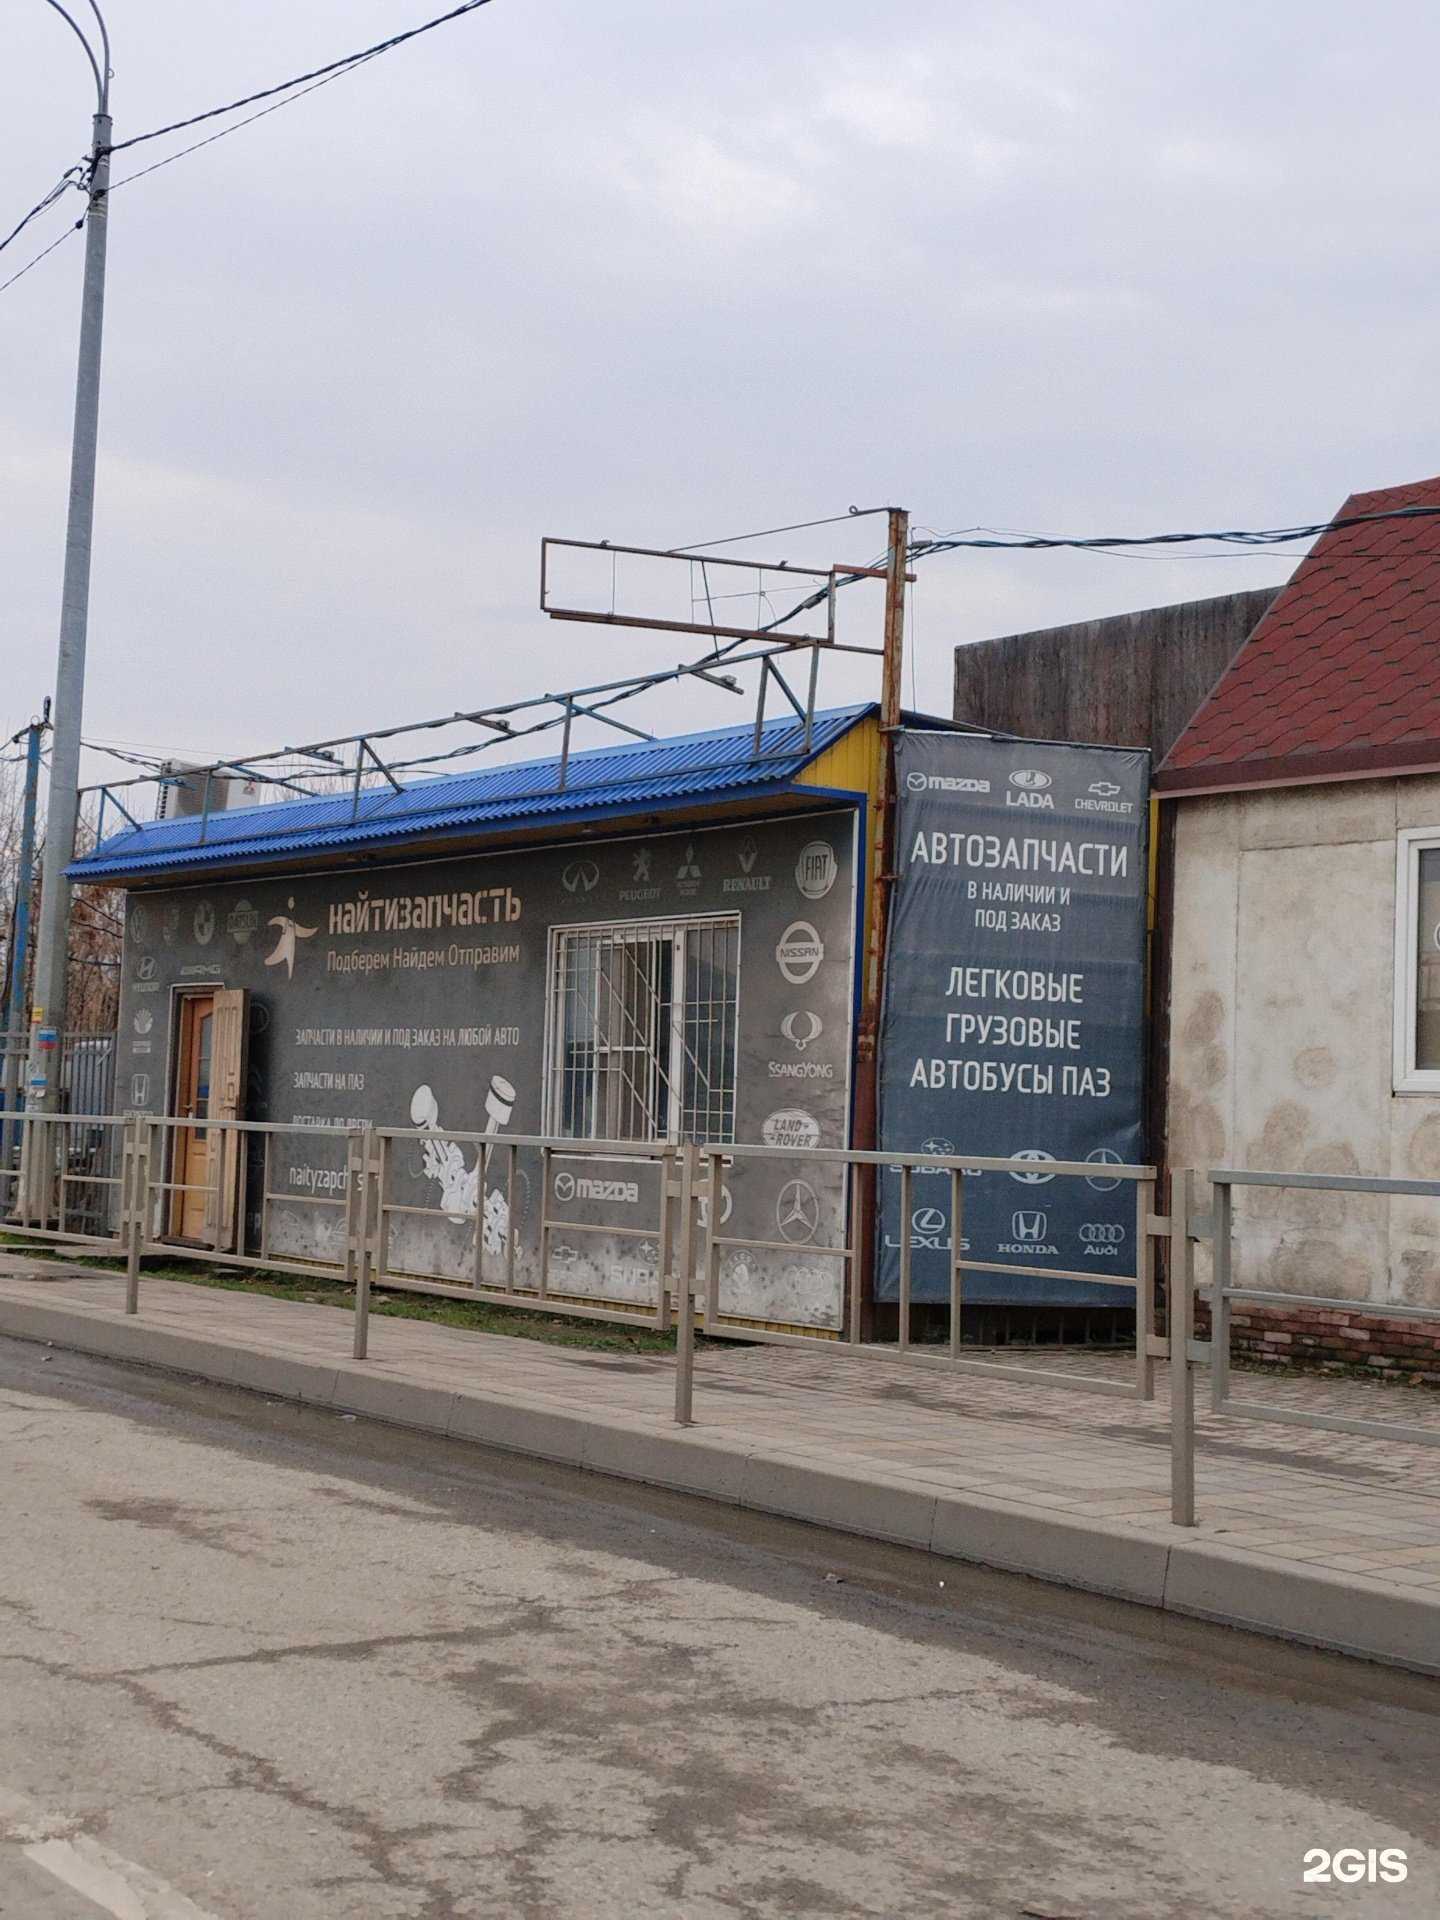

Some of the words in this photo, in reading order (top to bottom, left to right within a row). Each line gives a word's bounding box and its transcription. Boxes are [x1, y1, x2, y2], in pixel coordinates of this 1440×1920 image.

[1006, 791, 1054, 809] LADA
[1075, 798, 1133, 814] CHEVROLET
[910, 831, 1128, 877] АВТОЗАПЧАСТИ
[806, 854, 828, 880] FIAT
[967, 881, 977, 899] В
[982, 882, 1055, 904] НАЛИЧИИ
[1060, 887, 1071, 905] И
[975, 909, 1008, 932] ПОД
[1011, 911, 1061, 932] ЗАКАЗ
[328, 951, 389, 974] Подберем
[393, 947, 443, 970] Найдем
[449, 943, 520, 969] Отправим
[781, 946, 819, 957] NISSAN
[945, 966, 1084, 1003] ЛЕГКОВЫЕ
[295, 1029, 335, 1046] ЗАПЧАСТИ
[337, 1029, 342, 1046] В
[344, 1029, 383, 1046] НАЛИЧИИ
[384, 1029, 391, 1046] И
[392, 1028, 411, 1048] ПОД
[412, 1028, 440, 1046] ЗАКАЗ
[443, 1028, 456, 1046] НА
[457, 1024, 492, 1046] ЛЮБОЙ
[494, 1027, 519, 1046] АВТО
[946, 1013, 1081, 1049] ГРУЗОВЫЕ
[293, 1072, 334, 1089] ЗАПЧАСТИ
[335, 1072, 346, 1090] НА
[348, 1073, 364, 1090] ПАЗ
[910, 1058, 1053, 1094] АВТОБУСЫ
[1062, 1065, 1110, 1097] ПАЗ
[775, 1119, 802, 1132] LAND
[885, 1235, 970, 1250] LEXUS
[997, 1243, 1059, 1255] HONDA
[1084, 1244, 1118, 1256] Audi
